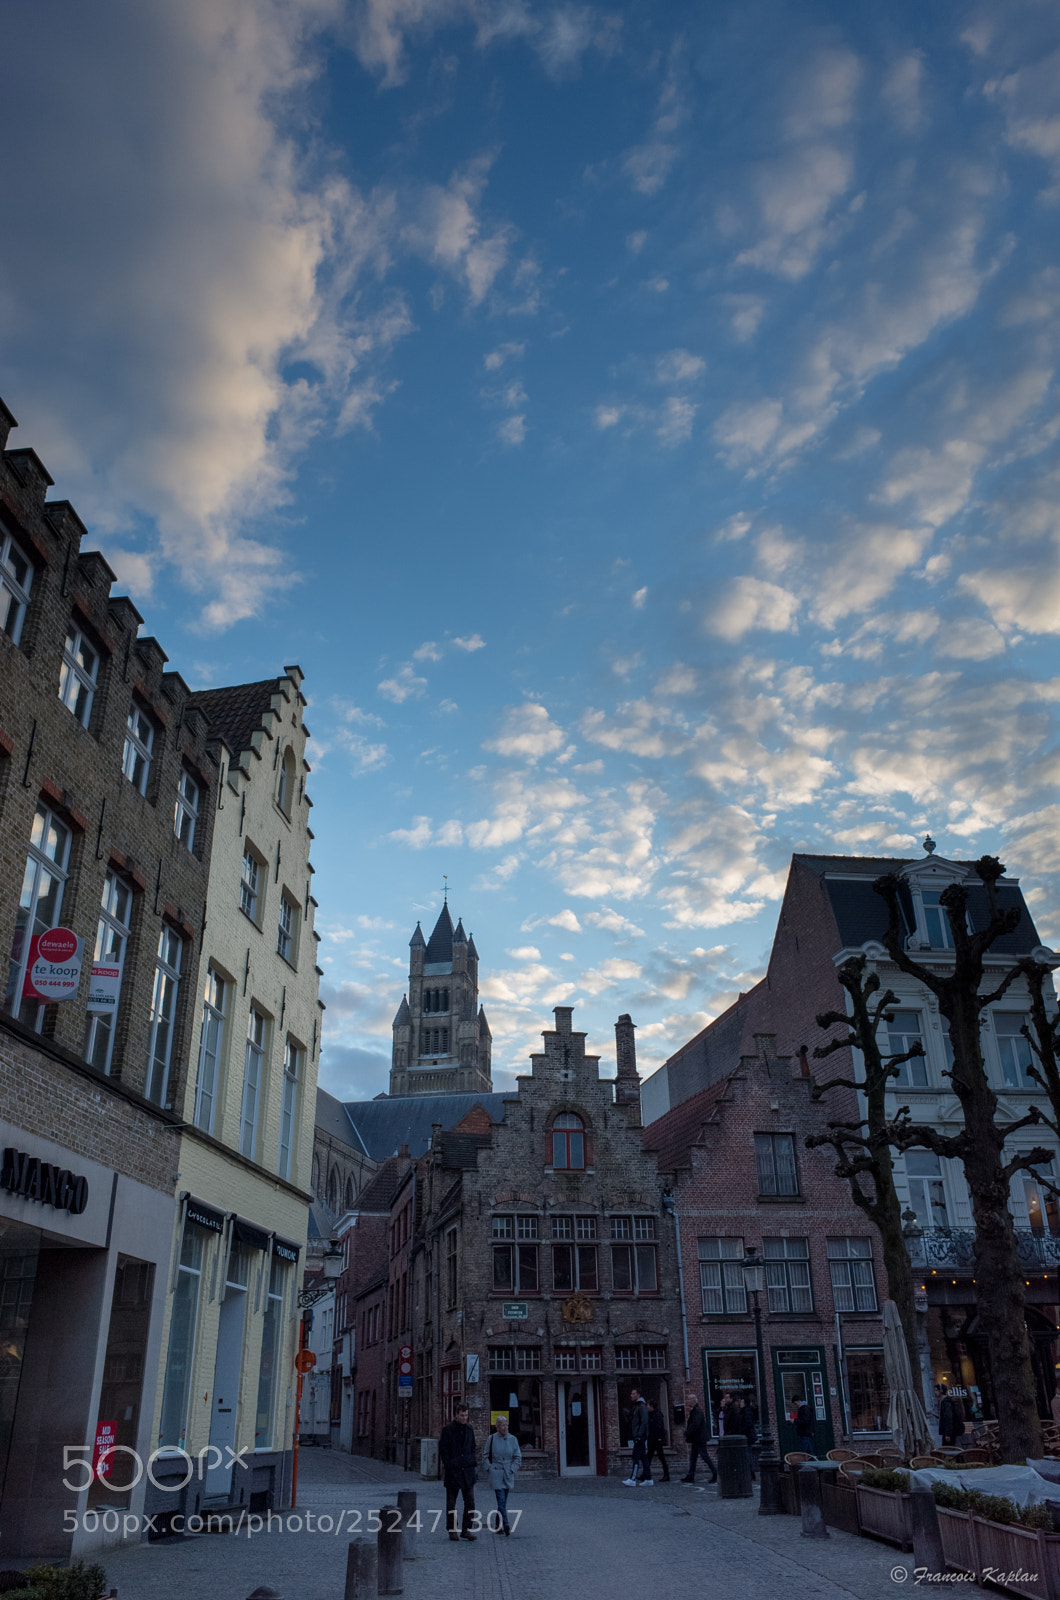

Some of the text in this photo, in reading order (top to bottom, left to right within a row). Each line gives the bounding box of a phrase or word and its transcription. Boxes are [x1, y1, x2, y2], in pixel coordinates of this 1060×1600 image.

[41, 939, 74, 949] dewaele
[35, 964, 78, 978] te koop
[97, 968, 118, 976] koop
[0, 1148, 88, 1214] MANGO
[947, 1386, 968, 1397] ellis
[101, 1426, 111, 1435] MID
[96, 1435, 115, 1445] SEASON
